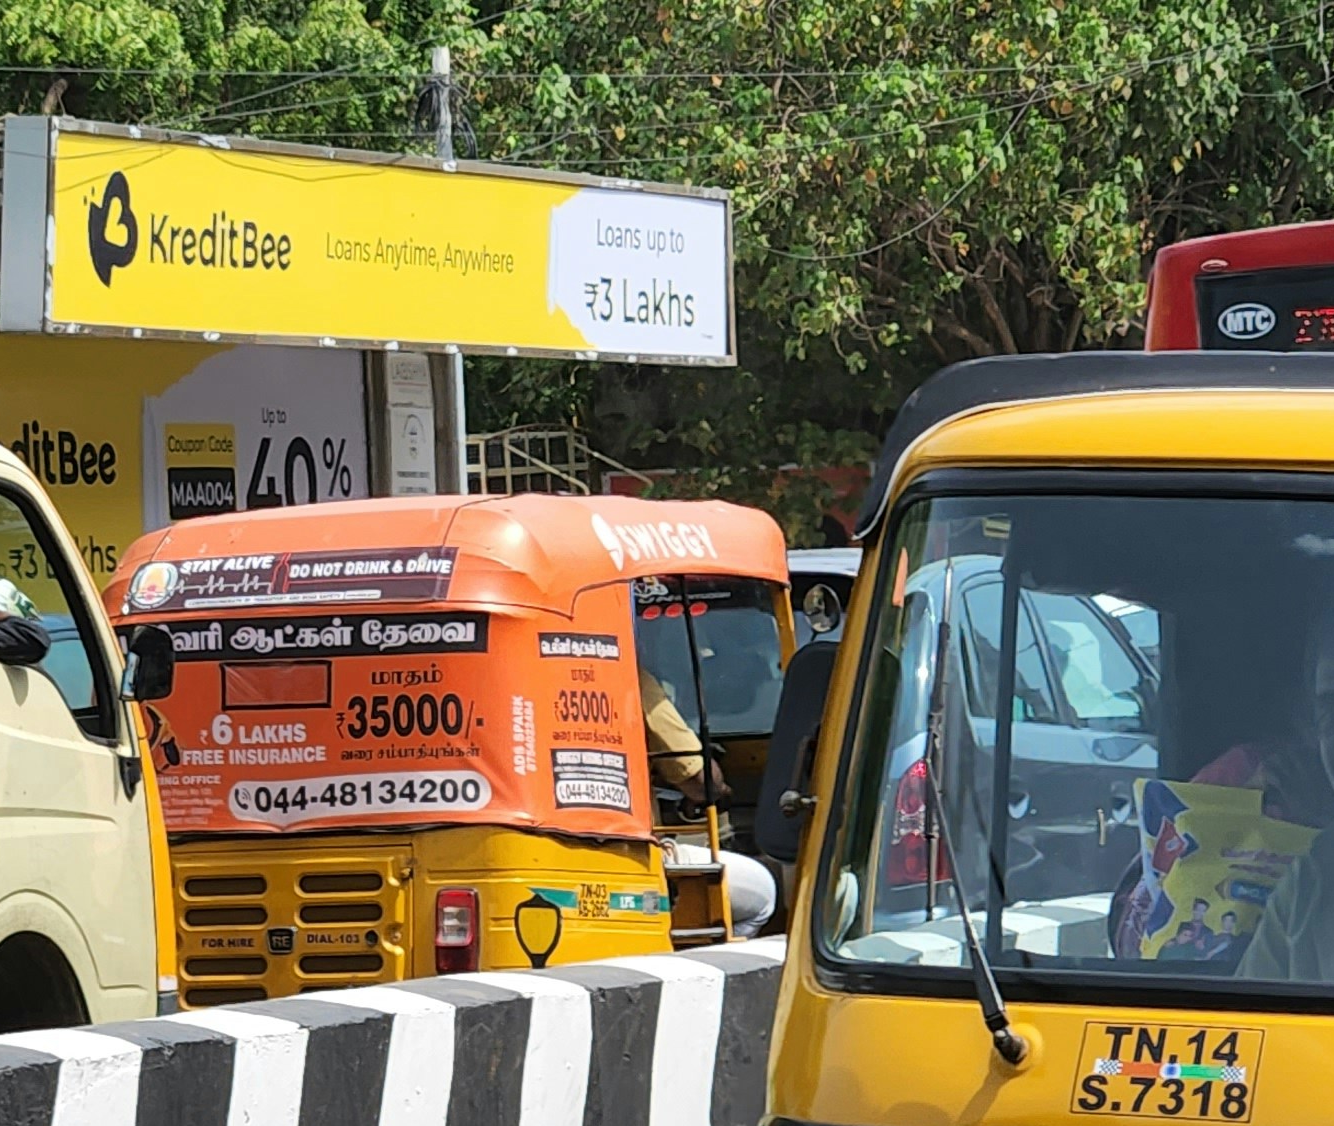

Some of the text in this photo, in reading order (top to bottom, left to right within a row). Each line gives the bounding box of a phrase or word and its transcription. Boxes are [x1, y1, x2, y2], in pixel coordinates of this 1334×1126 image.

[149, 211, 291, 270] KreditBee
[596, 218, 685, 258] Loans up to
[326, 232, 514, 274] Loans Anytime, Anywhere
[584, 277, 695, 328] ₹3 Lakhs
[1225, 311, 1270, 332] MTC
[261, 408, 287, 426] Up to
[12, 420, 117, 485] ditBee
[168, 436, 234, 455] Coupon Code
[170, 481, 234, 507] MAA004
[615, 522, 718, 561] SWIGGY
[179, 556, 275, 574] STAY ALIVE
[290, 563, 315, 580] DO
[316, 562, 343, 577] NOT
[344, 561, 390, 576] DRINK
[391, 560, 404, 575] &
[230, 617, 354, 653] ஆட்கள்
[361, 618, 476, 651] தேவை
[371, 663, 443, 688] மாதம்
[512, 695, 524, 742] SPARK
[239, 723, 307, 744] LAKHS
[182, 746, 327, 767] FREE INSURANCE
[341, 747, 374, 762] வரை
[181, 775, 221, 785] OFFICE
[254, 778, 481, 814] 044-48134200
[201, 938, 255, 948] FOR HIRE
[307, 934, 360, 944] DIAL-103
[1106, 1027, 1240, 1066] TN.14
[1078, 1075, 1249, 1120] S.7318
